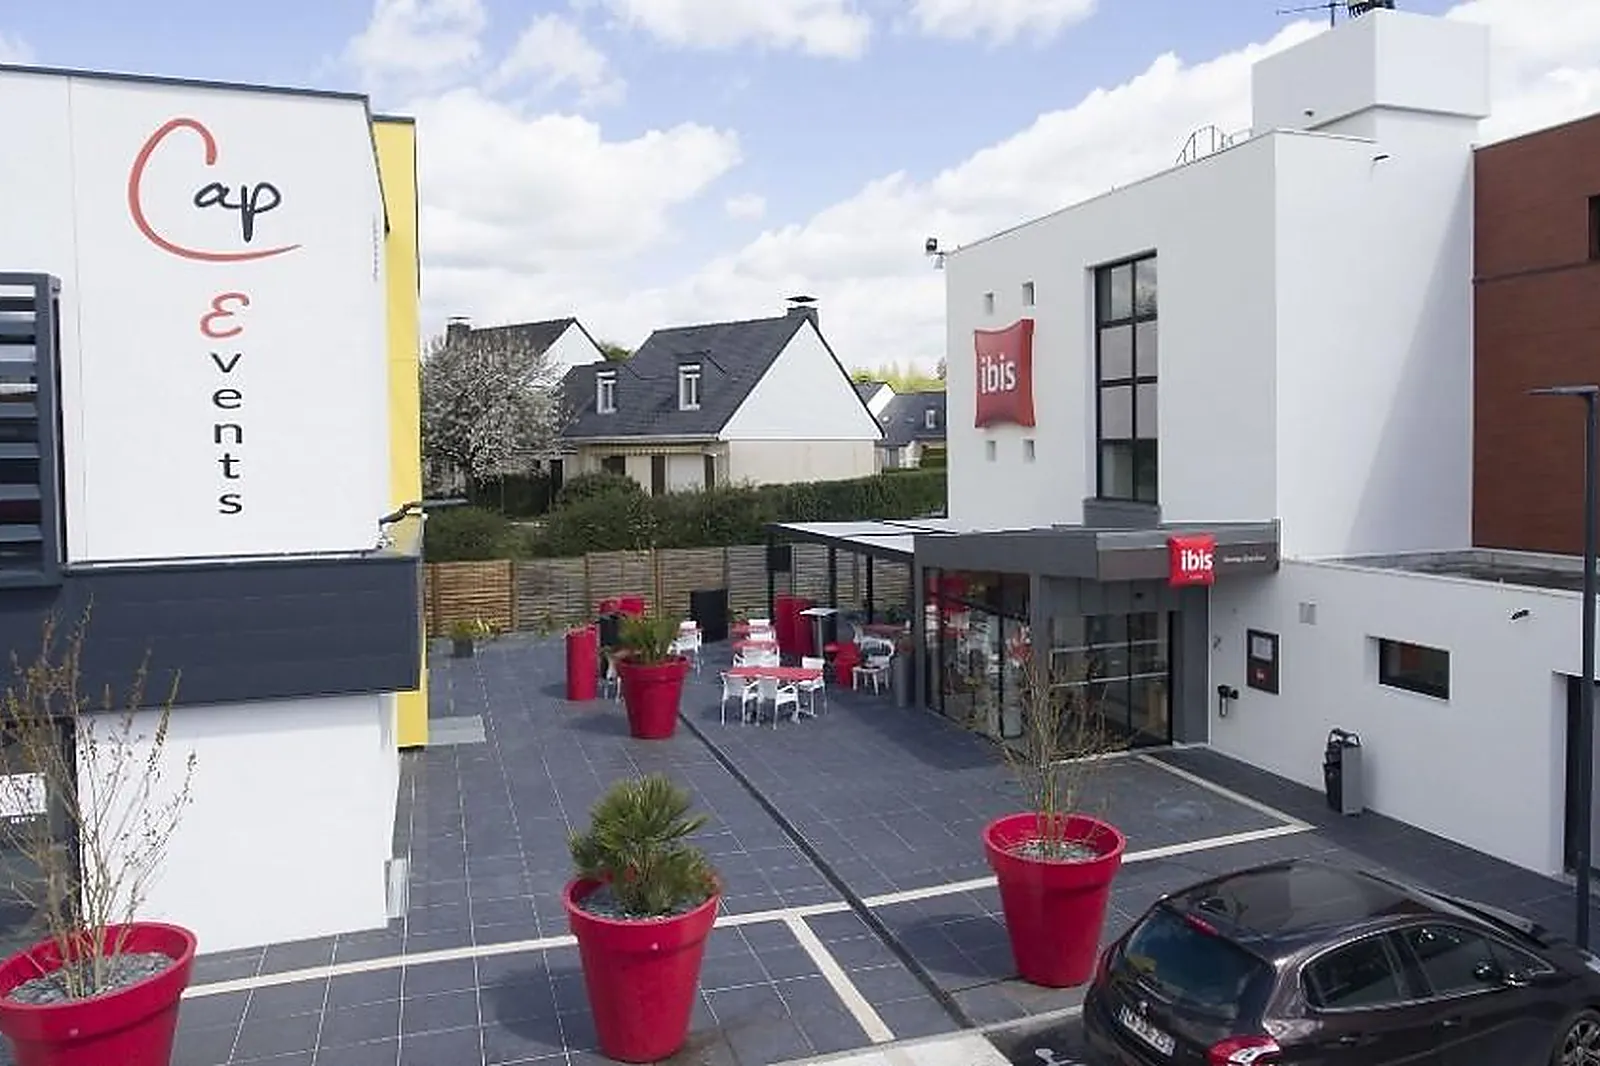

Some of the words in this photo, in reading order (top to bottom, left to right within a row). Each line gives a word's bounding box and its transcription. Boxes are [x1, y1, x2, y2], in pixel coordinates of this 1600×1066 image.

[128, 118, 301, 262] Cap
[200, 292, 250, 515] Events
[981, 353, 1016, 394] ibis
[1181, 549, 1213, 571] ibis
